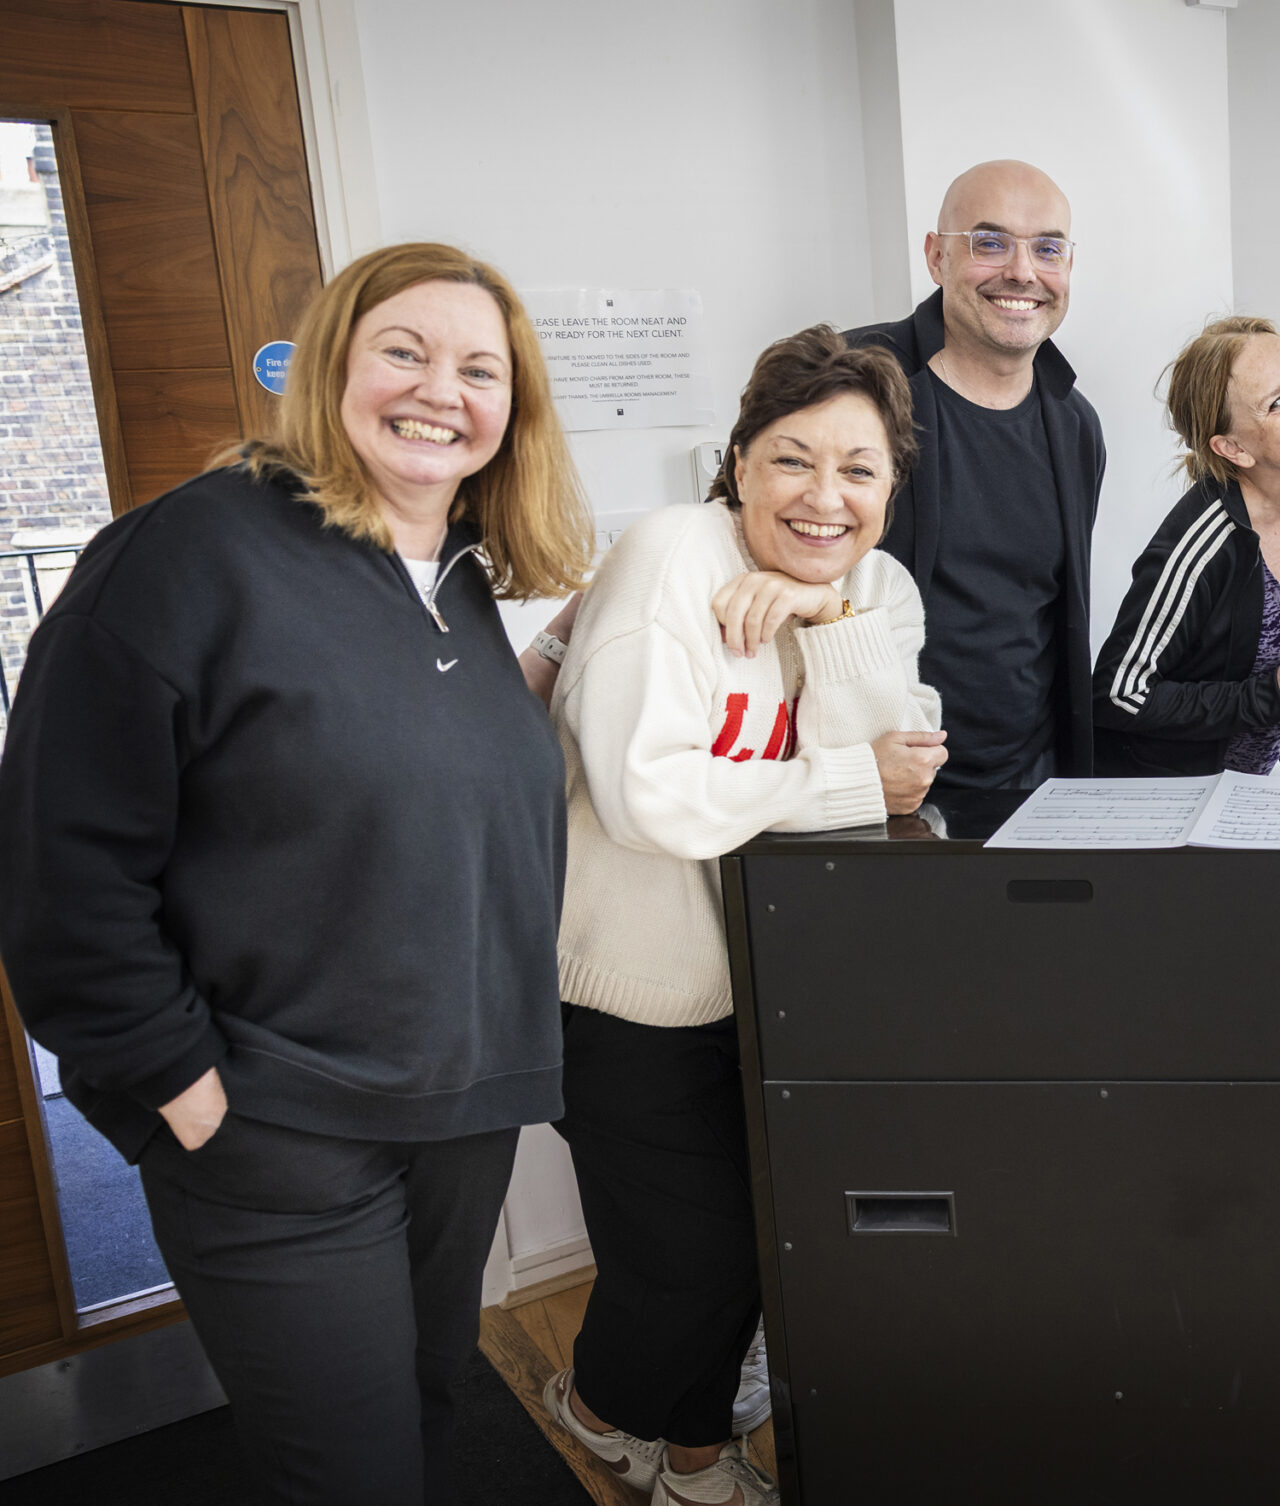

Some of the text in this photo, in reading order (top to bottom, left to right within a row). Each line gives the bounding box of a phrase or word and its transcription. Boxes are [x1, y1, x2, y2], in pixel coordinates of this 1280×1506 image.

[532, 316, 687, 327] LEASE LEAVE THE ROOM NEAT AND
[537, 329, 684, 340] IDY READY FOR THE NEXT CLIENT.
[266, 358, 282, 367] Fire
